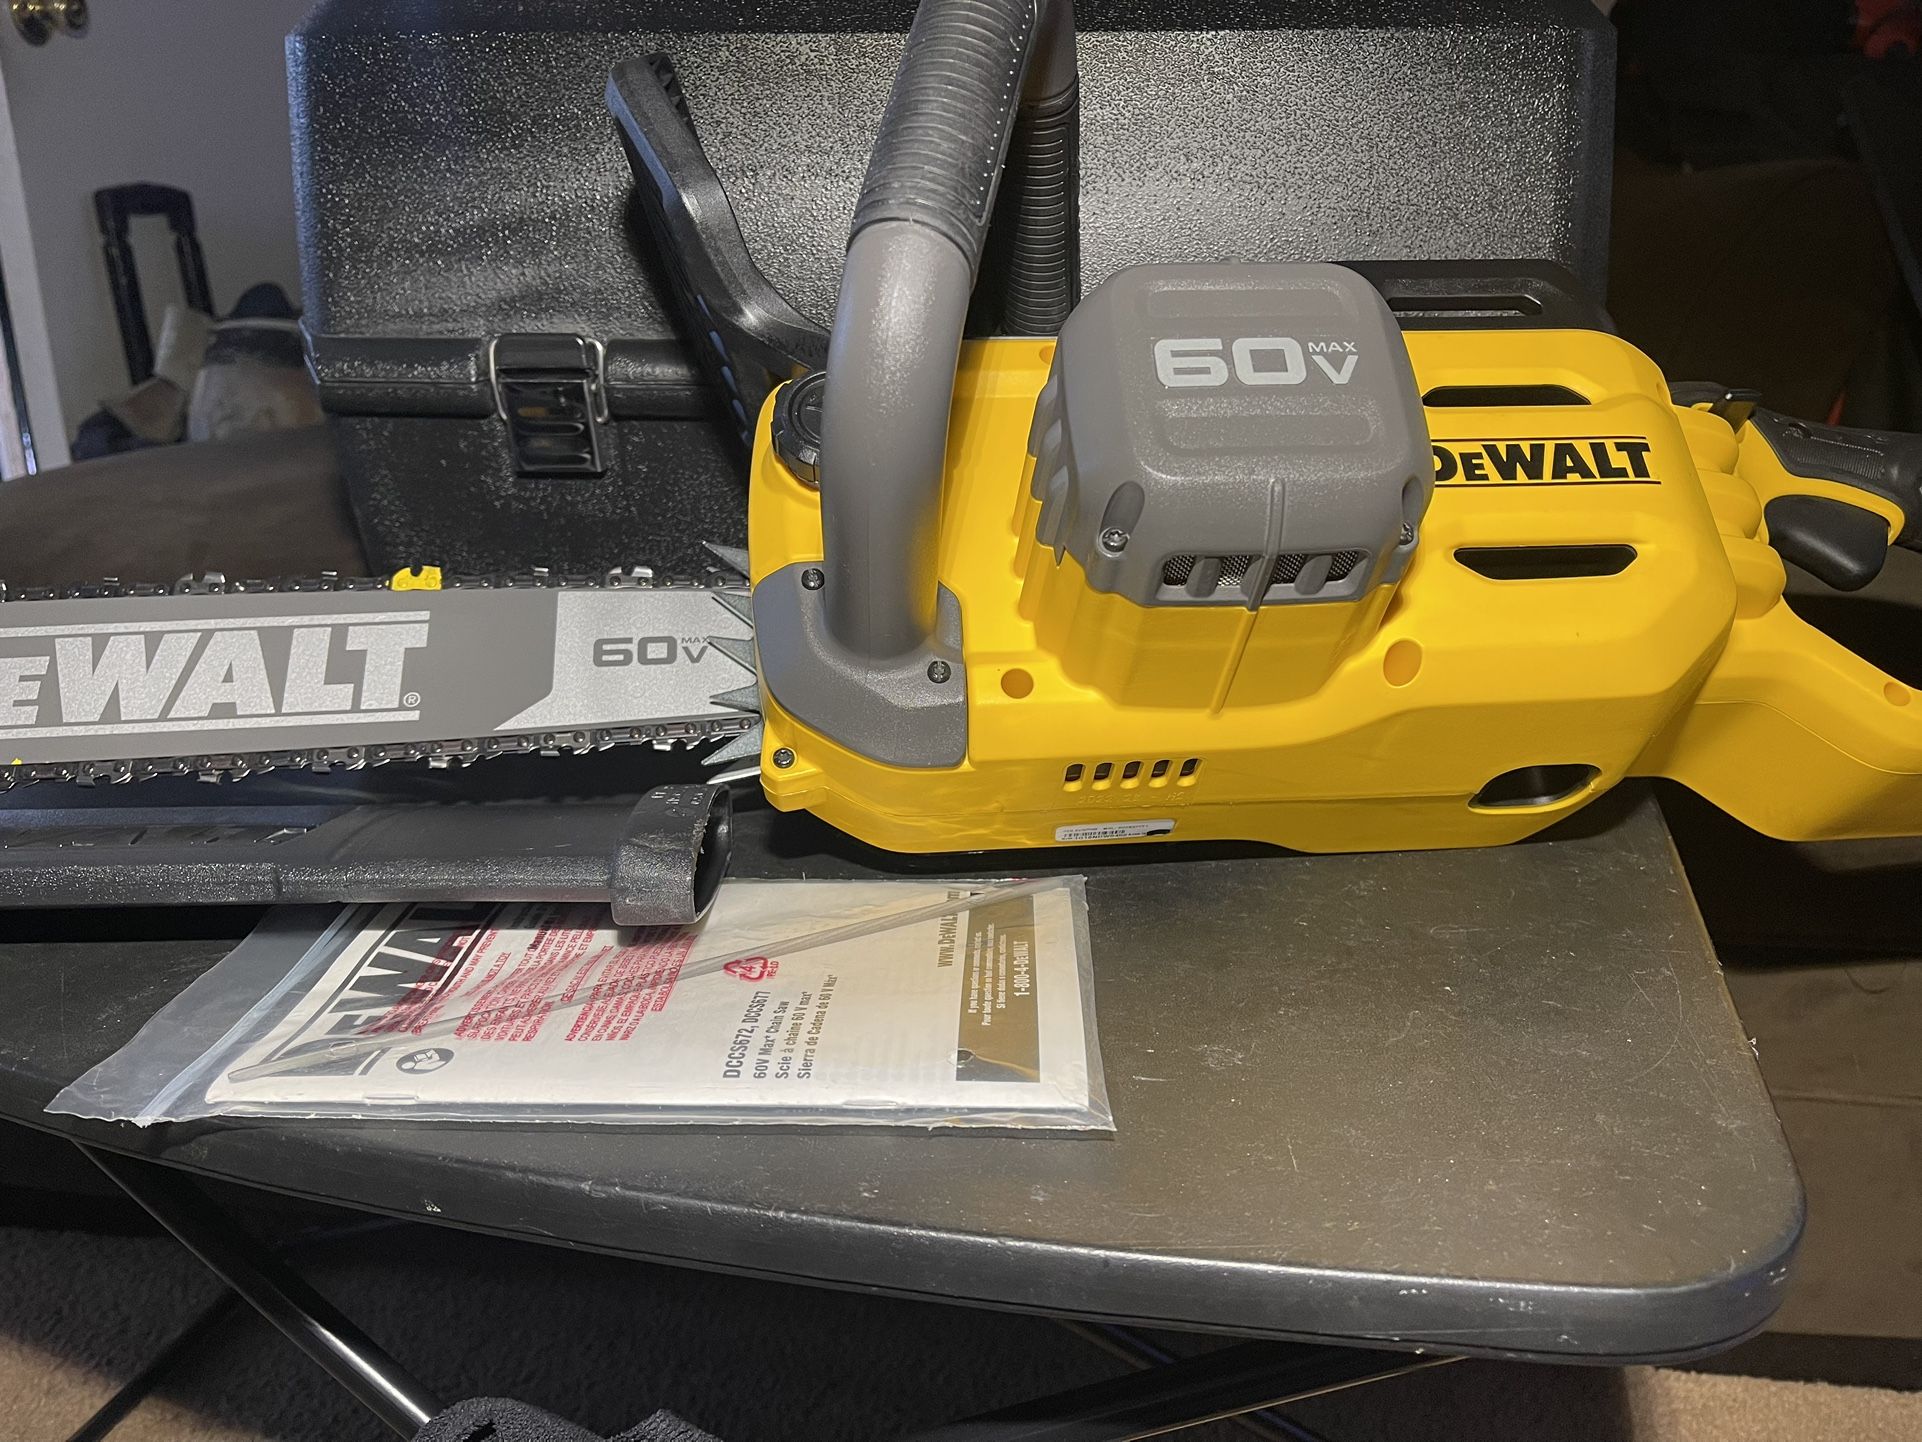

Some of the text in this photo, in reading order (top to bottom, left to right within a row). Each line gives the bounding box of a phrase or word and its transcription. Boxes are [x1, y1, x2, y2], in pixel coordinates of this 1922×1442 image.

[1308, 342, 1358, 353] MAX
[816, 1001, 830, 1010] de
[818, 992, 832, 1001] 60
[773, 1000, 790, 1014] Saw
[765, 1014, 785, 1034] Chain
[807, 1010, 827, 1035] Cadena
[723, 991, 771, 1078] DCCS672, DCCS677
[804, 1036, 819, 1046] de
[775, 1056, 792, 1079] Scie
[791, 1012, 806, 1021] 60
[753, 1058, 770, 1079] 60V
[797, 1048, 816, 1079] Sierra
